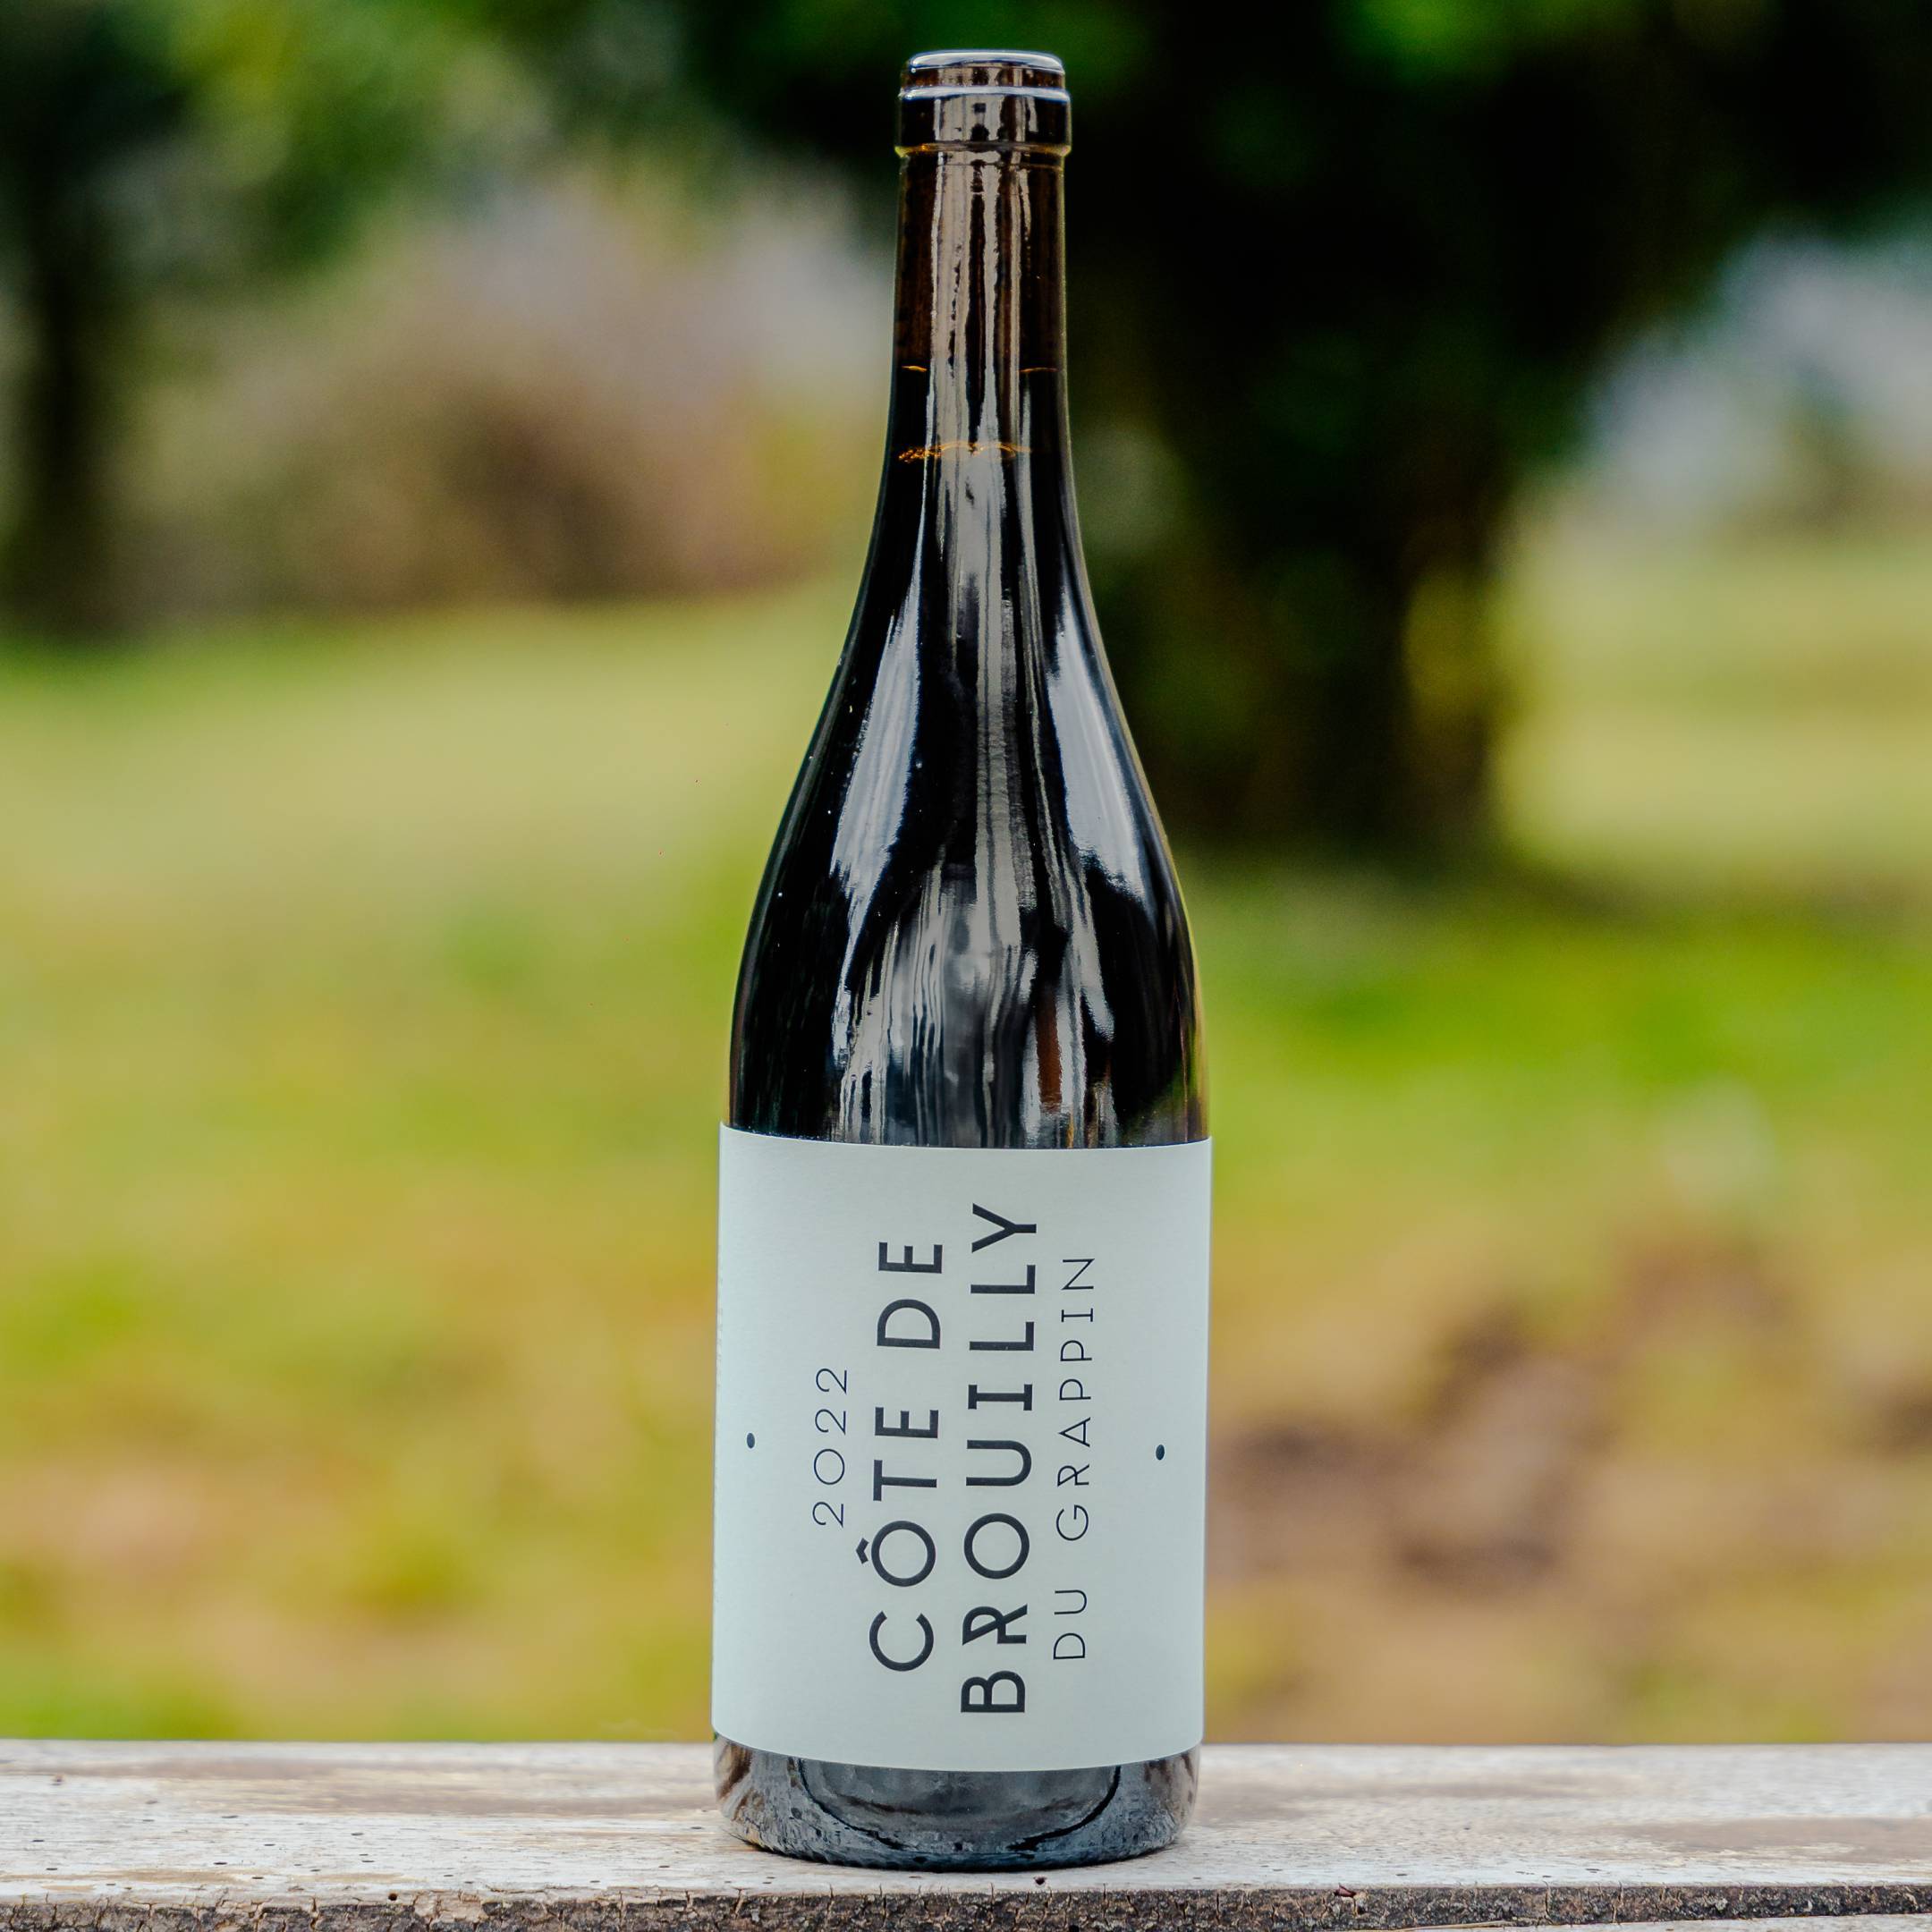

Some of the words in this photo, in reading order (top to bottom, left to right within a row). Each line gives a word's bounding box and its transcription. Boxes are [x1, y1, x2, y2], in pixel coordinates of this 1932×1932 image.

[876, 1241, 944, 1350] DE
[1055, 1258, 1096, 1542] GRAPPIN
[811, 1368, 848, 1530] 2022
[855, 1406, 939, 1673] CÔTE
[960, 1202, 1038, 1714] BROUILLY
[1052, 1589, 1088, 1661] DU
